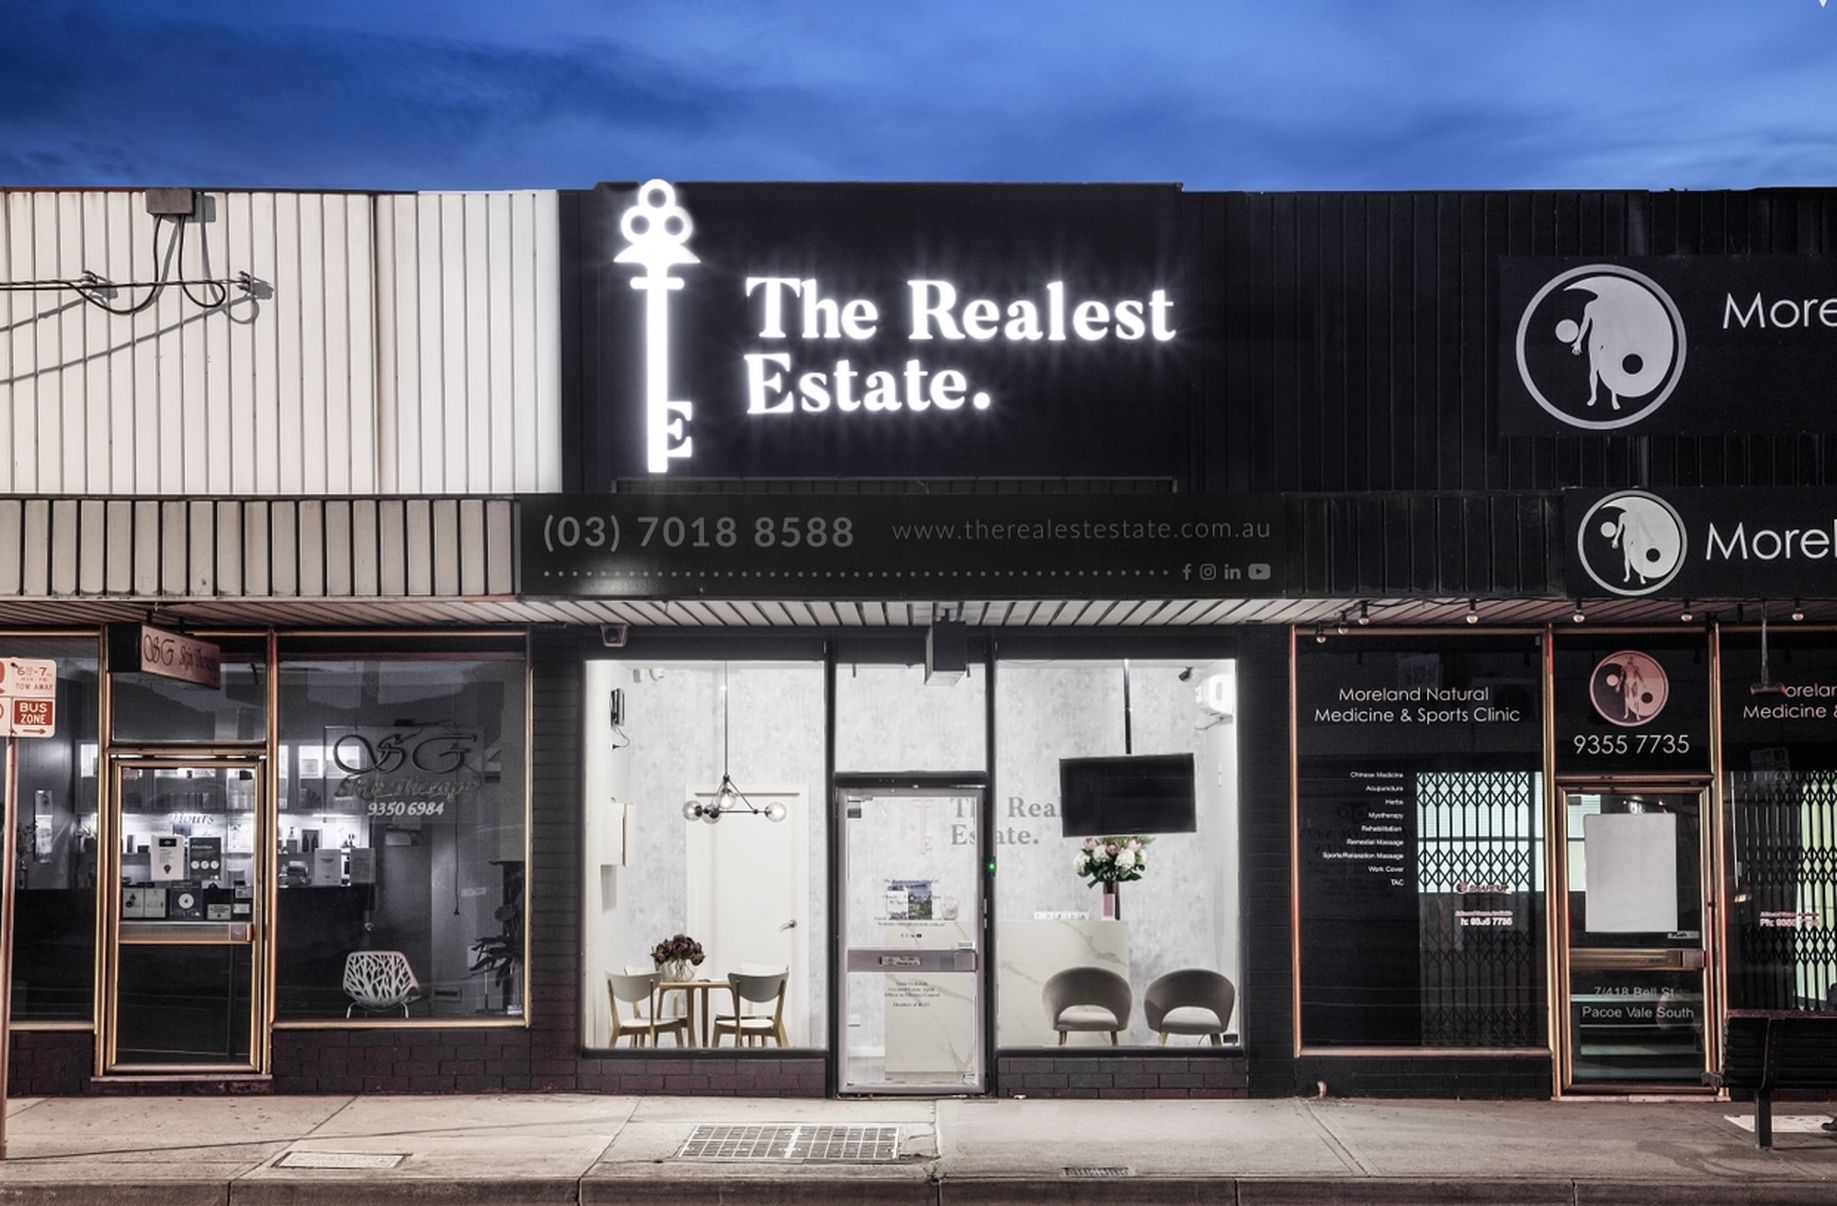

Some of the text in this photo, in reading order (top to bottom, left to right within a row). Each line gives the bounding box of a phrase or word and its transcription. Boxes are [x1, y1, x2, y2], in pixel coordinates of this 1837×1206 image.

[746, 276, 1176, 341] The Realest
[744, 352, 991, 414] Estate.
[542, 514, 854, 552] (03) 7018 8588
[892, 519, 1271, 541] www.therealestestate.com.au
[1339, 687, 1489, 702] Moreland Natural
[1785, 683, 1837, 697] orelan
[19, 702, 48, 713] BUS
[1743, 704, 1827, 719] Medicine
[20, 714, 47, 724] ZONE
[1314, 707, 1520, 724] Medicine & Sports Clinic
[1573, 735, 1690, 755] 9355 7735
[367, 801, 445, 816] 9350 6984
[1594, 986, 1629, 998] 7/418
[1633, 986, 1657, 998] Bell
[1582, 1005, 1695, 1019] Pacoe Vale South
